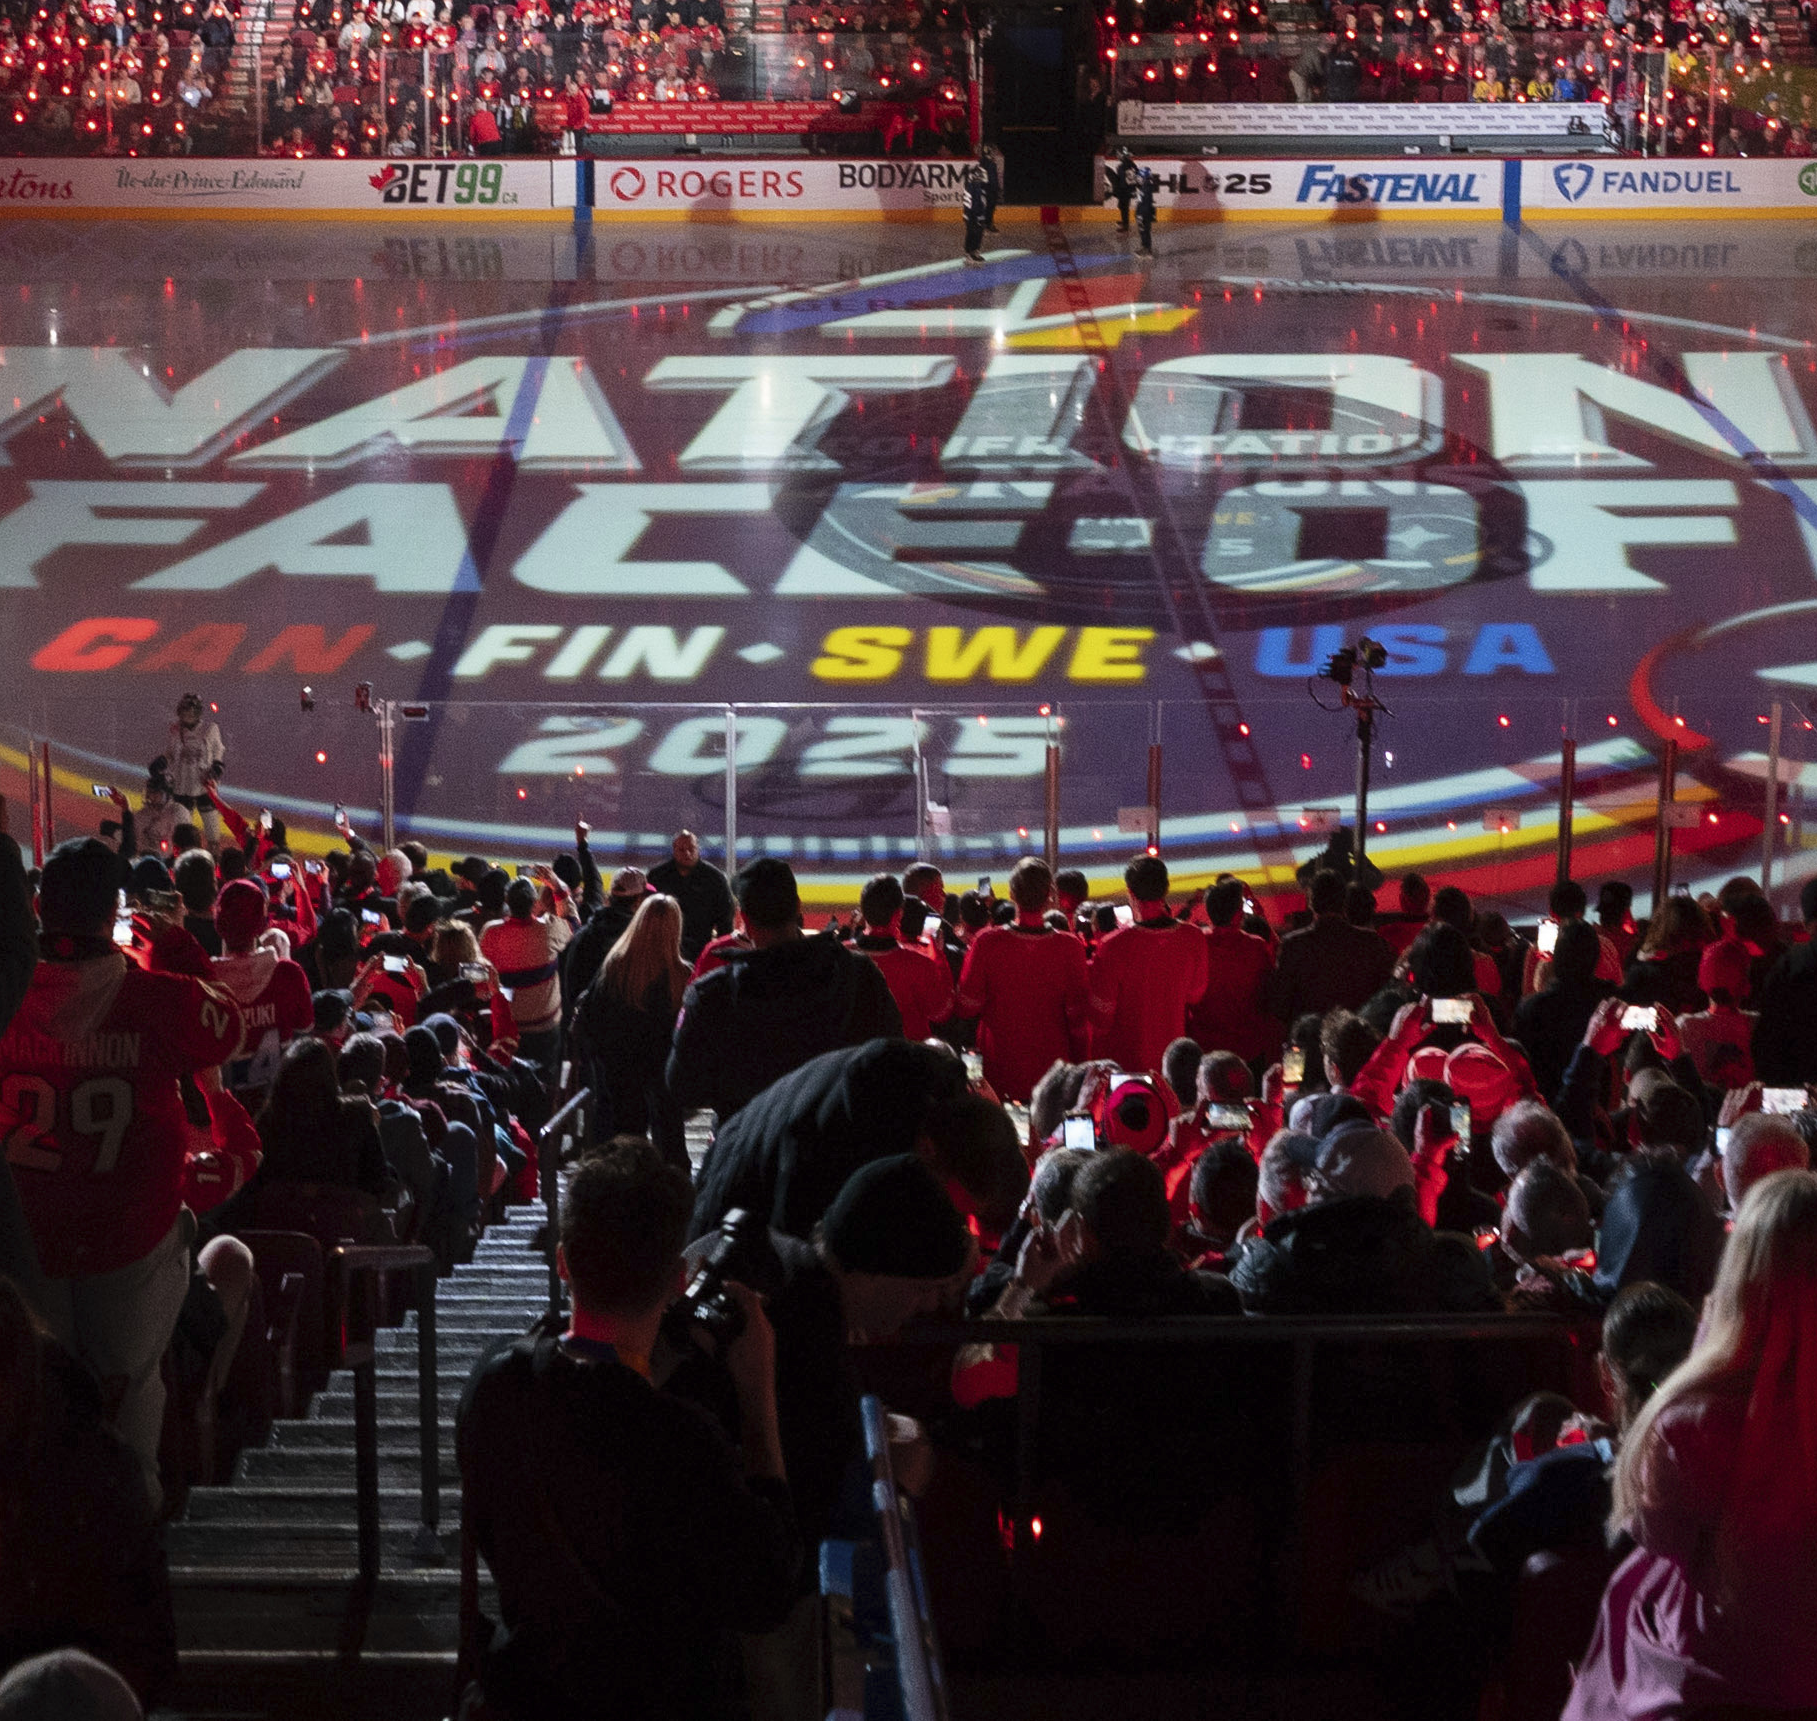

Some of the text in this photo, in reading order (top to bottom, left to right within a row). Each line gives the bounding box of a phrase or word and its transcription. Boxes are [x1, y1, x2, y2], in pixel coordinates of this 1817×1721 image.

[657, 170, 804, 198] ROGERS
[1295, 164, 1481, 203] FASTENAL
[1603, 170, 1741, 193] FANDUEL
[32, 617, 1556, 681] CAN FIN SWE USA
[497, 715, 1062, 777] 2025
[1, 1072, 133, 1174] 29
